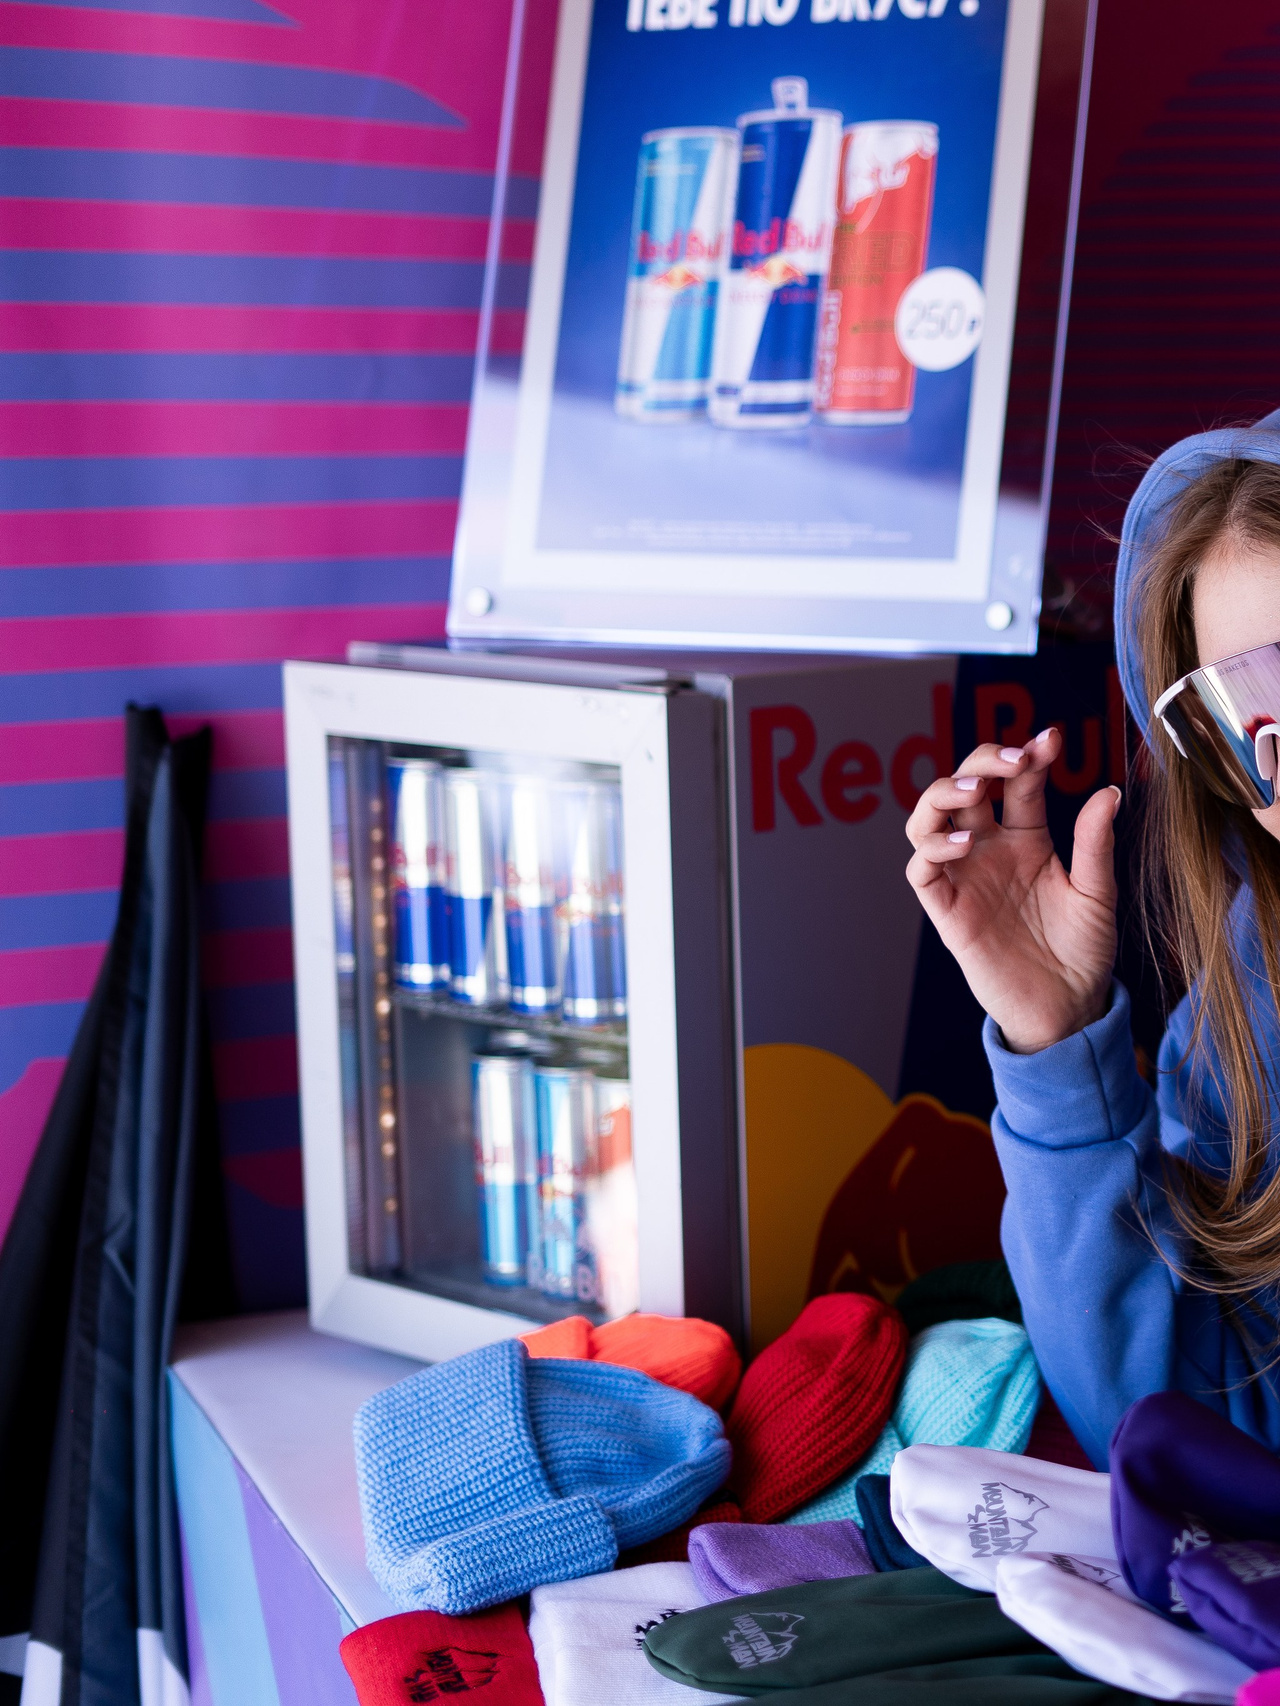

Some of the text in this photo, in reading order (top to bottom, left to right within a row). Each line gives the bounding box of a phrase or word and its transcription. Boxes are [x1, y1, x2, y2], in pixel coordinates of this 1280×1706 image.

[749, 664, 1132, 834] Red Bul
[968, 1523, 993, 1558] MAN
[980, 1481, 1013, 1556] MOUNTAIN
